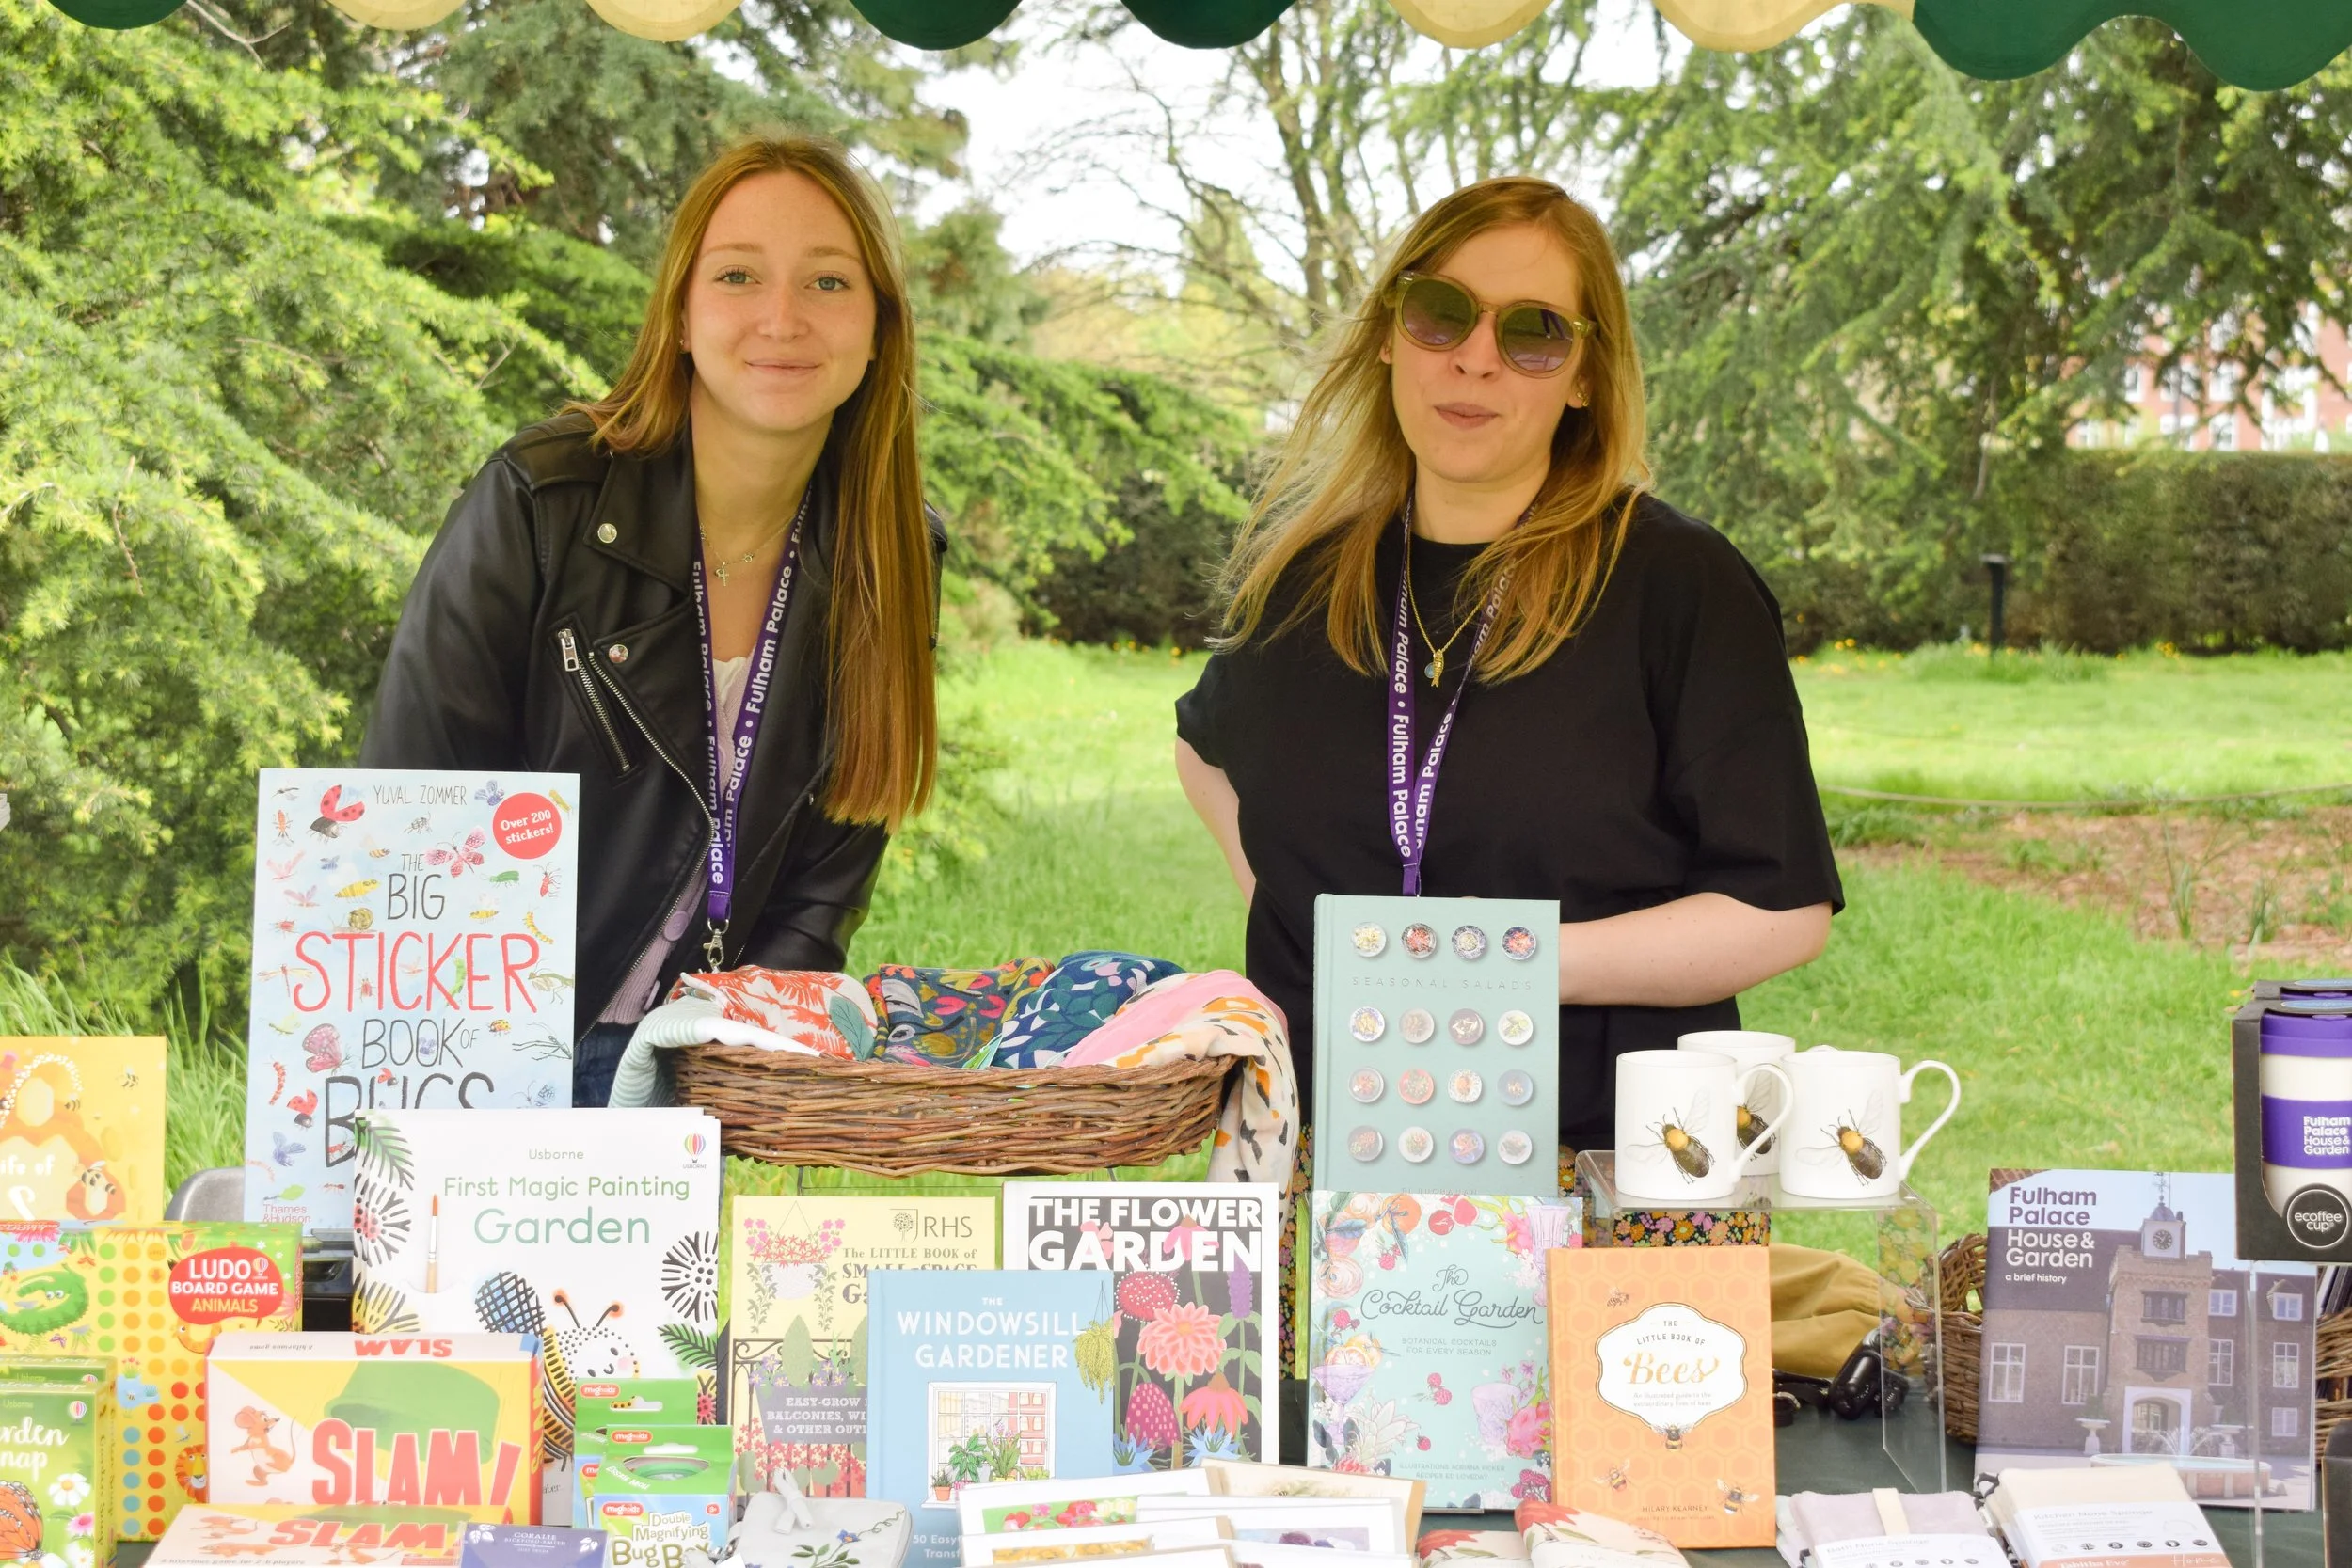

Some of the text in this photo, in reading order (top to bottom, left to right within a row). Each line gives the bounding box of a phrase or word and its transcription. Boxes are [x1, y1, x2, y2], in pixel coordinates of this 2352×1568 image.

[745, 564, 792, 714] Fulham Palace
[1394, 632, 1409, 694] Palace
[1422, 713, 1453, 778] Palace
[725, 735, 753, 802] Palace
[374, 784, 467, 806] YUVAL ZOMMER
[1392, 714, 1411, 858] Fulham Palace
[501, 809, 552, 832] Over 200
[505, 822, 555, 845] stickers!
[401, 853, 423, 872] THE
[388, 873, 446, 921] BIG
[294, 931, 540, 1014] STICKER
[1352, 976, 1533, 990] SEASONAL SALADS
[361, 1018, 480, 1070] BOOK OF
[2303, 1116, 2352, 1128] Fulham
[2303, 1126, 2348, 1136] Palace
[528, 1148, 585, 1161] Usborne
[2303, 1145, 2350, 1157] Garden
[0, 1153, 56, 1176] ife of
[444, 1176, 691, 1202] First Magic Painting
[2010, 1186, 2098, 1208] Fulham
[263, 1204, 307, 1213] Thames
[1031, 1198, 1262, 1227] THE FLOWER
[2010, 1206, 2090, 1227] Palace
[2294, 1211, 2343, 1224] ecoffee
[474, 1206, 650, 1245] Garden
[924, 1216, 973, 1238] RHS
[2007, 1228, 2096, 1249] House&
[843, 1248, 978, 1259] The LITTLE BOOK of
[1029, 1230, 1262, 1272] GARDEN
[2006, 1248, 2093, 1268] Garden
[189, 1259, 252, 1280] LUDO
[1432, 1264, 1470, 1292] The
[2013, 1272, 2036, 1282] brief
[2036, 1273, 2067, 1285] history
[171, 1281, 278, 1296] BOARD GAME
[192, 1298, 258, 1313] ANIMALS
[982, 1296, 1004, 1306] THE
[1360, 1289, 1544, 1329] Cocktail Garden
[898, 1311, 1083, 1336] WINDOWSILL
[354, 1339, 453, 1357] SLAM
[1637, 1334, 1706, 1346] LITTLE BOOK OF
[915, 1343, 1069, 1368] GARDENER
[1623, 1352, 1720, 1385] Bees
[3, 1400, 34, 1409] Usborne
[786, 1397, 862, 1407] EASY-GROW
[767, 1411, 844, 1422] BALCONIES,
[0, 1415, 70, 1447] rden
[773, 1424, 783, 1434] &
[787, 1424, 832, 1434] OTHER
[0, 1450, 49, 1482] nap
[312, 1418, 522, 1524] SLAM!
[651, 1513, 691, 1527] Double
[636, 1524, 709, 1543] Magnifying
[913, 1535, 927, 1544] 50
[612, 1537, 660, 1568] Bug
